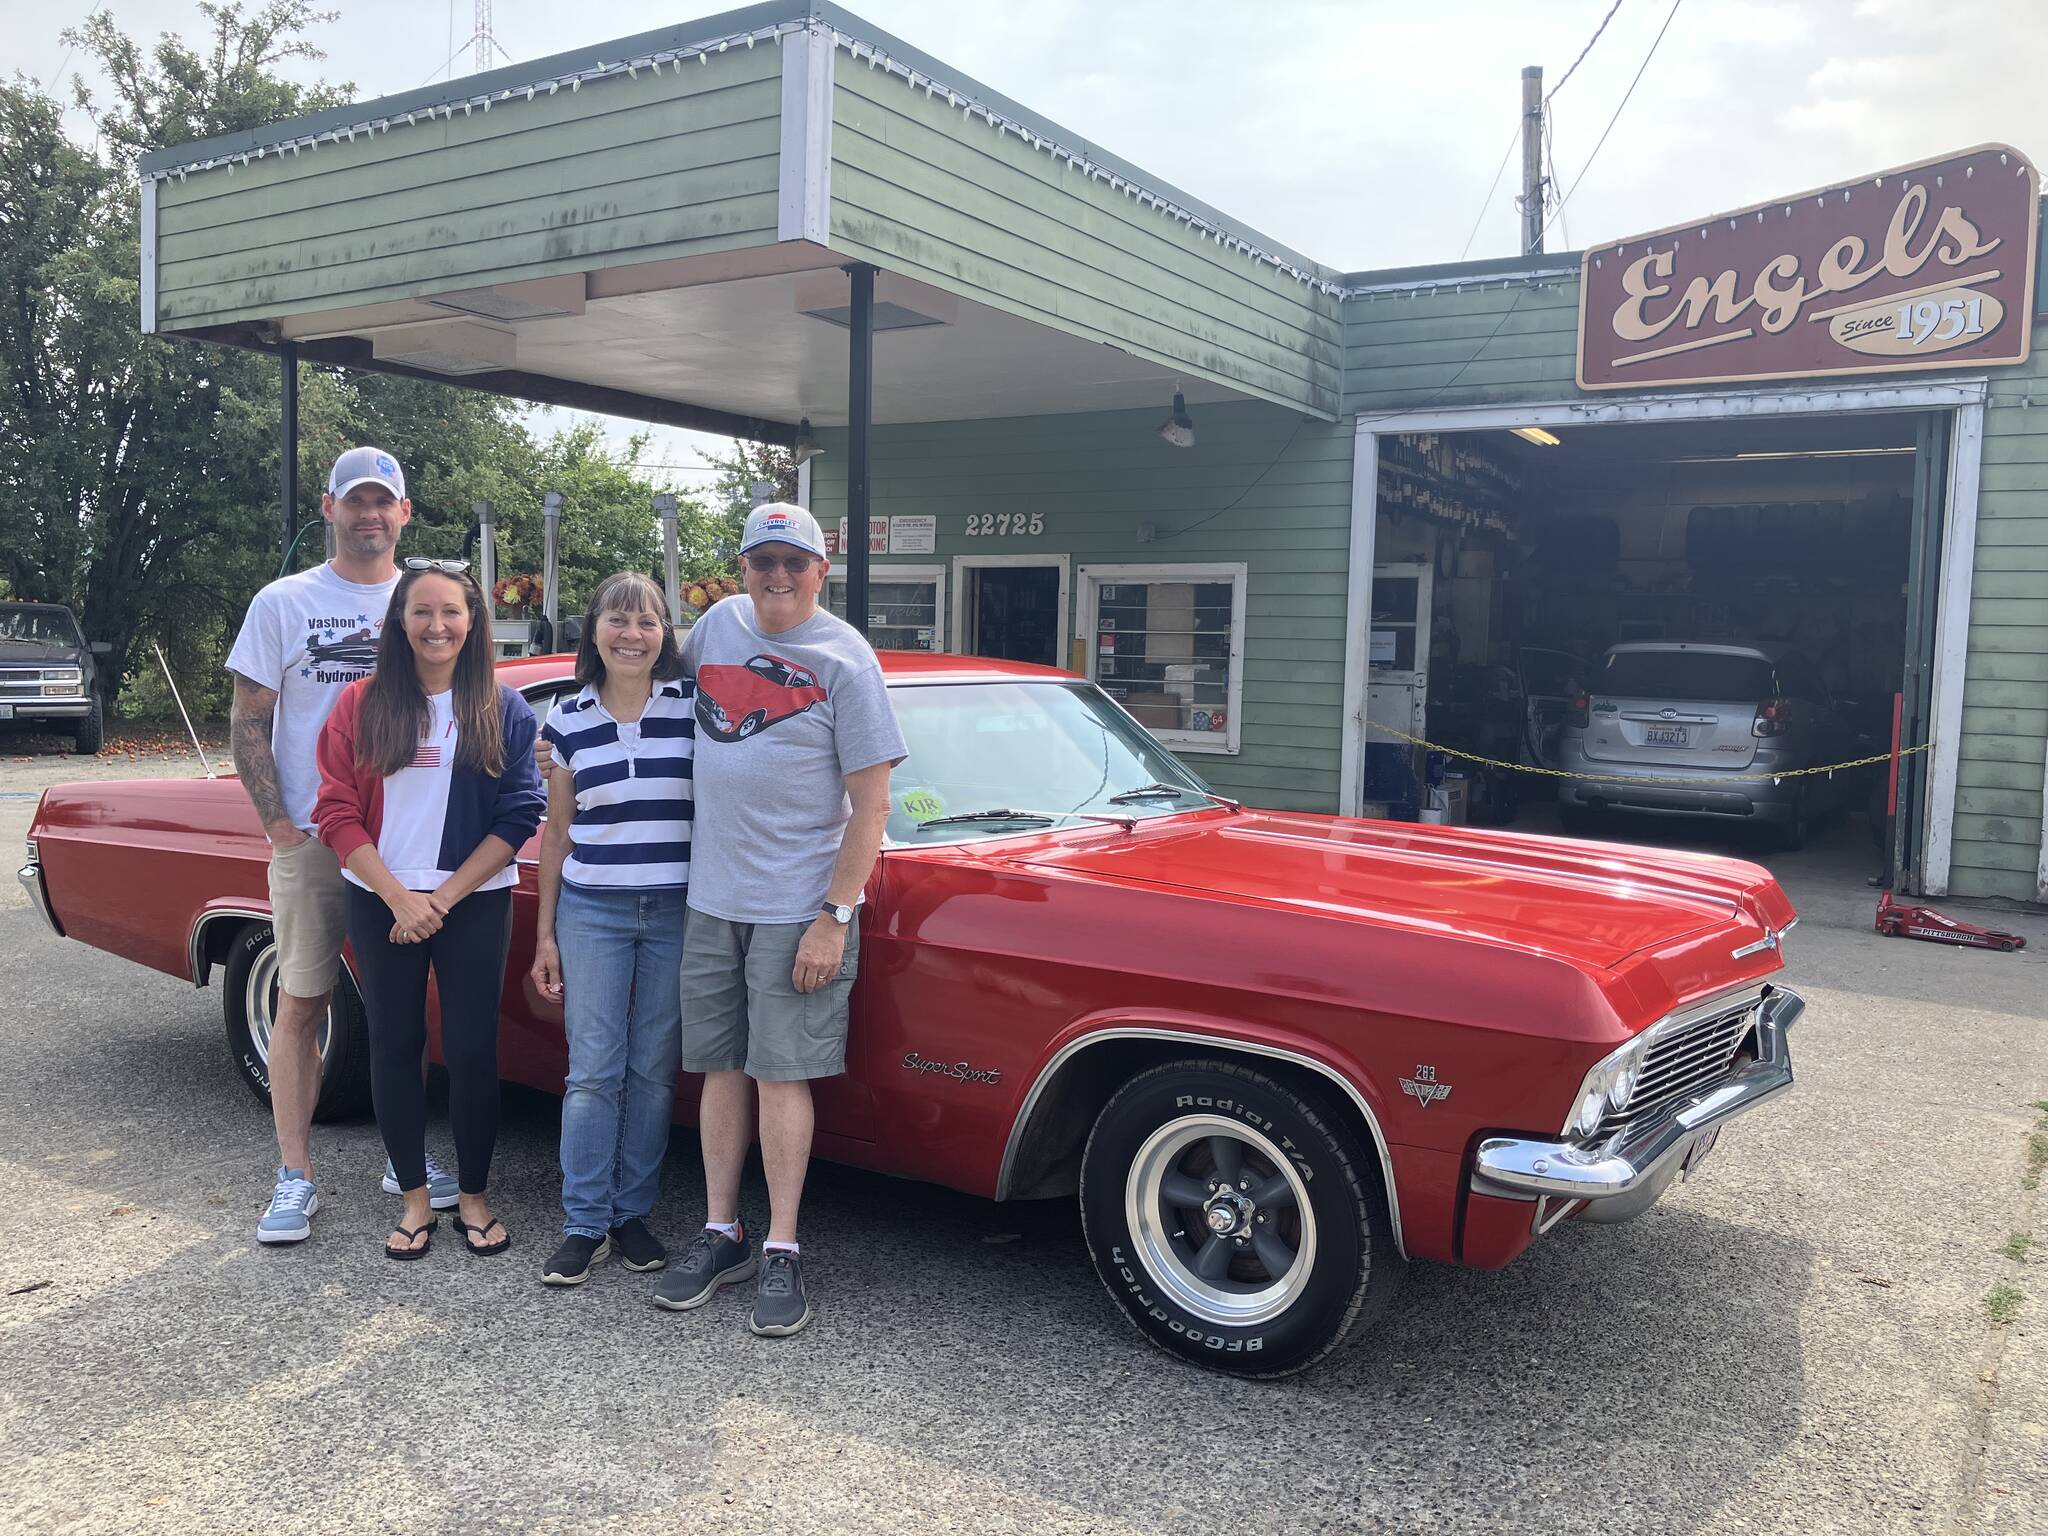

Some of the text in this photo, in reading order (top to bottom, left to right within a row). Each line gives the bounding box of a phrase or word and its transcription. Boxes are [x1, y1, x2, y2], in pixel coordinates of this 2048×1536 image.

[1612, 185, 2001, 341] Engels
[1840, 297, 1983, 345] Since 1951
[758, 519, 796, 528] CHEVROLET
[869, 521, 886, 535] OTOR
[965, 512, 1045, 536] 22725
[869, 537, 886, 551] KING
[308, 617, 356, 630] Vashon
[316, 670, 372, 683] Hydropl
[1212, 715, 1223, 725] 64
[904, 798, 938, 813] KJR
[246, 927, 272, 951] Rad
[1921, 928, 1974, 941] PITTSBURGH
[1416, 1064, 1435, 1080] 283
[1176, 1095, 1314, 1182] Radial T/A
[1112, 1246, 1264, 1352] BFGoodrich
